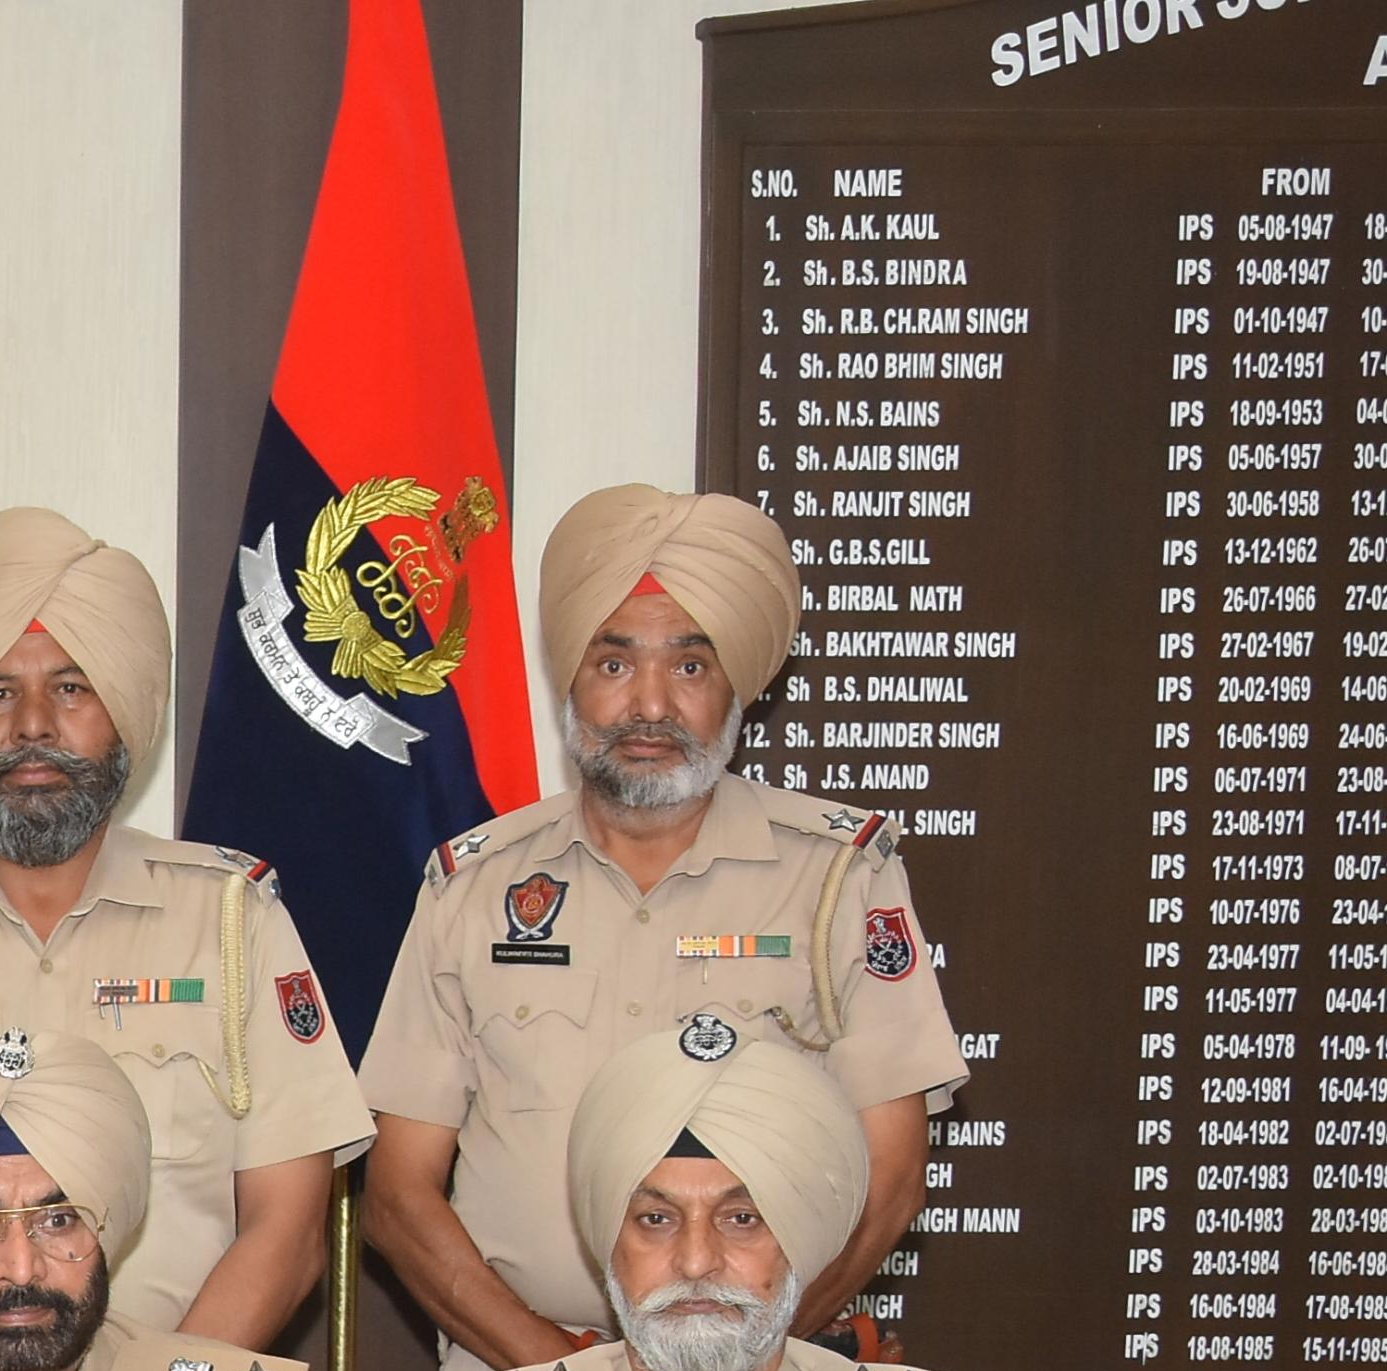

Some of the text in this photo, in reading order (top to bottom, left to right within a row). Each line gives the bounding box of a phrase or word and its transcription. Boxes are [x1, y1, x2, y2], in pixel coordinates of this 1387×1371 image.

[991, 0, 1204, 87] SENIOR
[752, 168, 1330, 197] S.NO. NAME FROM
[766, 216, 780, 241] 1.
[841, 214, 880, 240] A.K.
[887, 214, 939, 240] KAUL
[1179, 214, 1213, 240] IPS
[1239, 214, 1333, 241] 05-08-1947
[764, 261, 780, 286] 2.
[842, 259, 879, 285] B.S.
[886, 259, 967, 285] BINDRA
[1177, 259, 1211, 285] IPS
[1237, 258, 1330, 285] 19-08-1947
[762, 309, 779, 335] 3.
[841, 308, 878, 334] R.B.
[884, 308, 960, 334] CH.RAM
[966, 308, 1028, 334] SINGH
[1175, 308, 1209, 334] IPS
[1234, 307, 1328, 333] 01-10-1947
[760, 353, 777, 379] 4.
[838, 353, 878, 378] RAO
[885, 353, 935, 378] BHIM
[941, 353, 1003, 379] SINGH
[1173, 354, 1207, 379] IPS
[1233, 352, 1324, 378] 11-02-1951
[759, 401, 776, 426] 5.
[836, 401, 874, 427] N.S.
[880, 401, 939, 427] BAINS
[1170, 401, 1204, 427] IPS
[1230, 399, 1322, 426] 18-09-1953
[758, 445, 775, 471] 6.
[833, 445, 892, 471] AJAIB
[897, 445, 959, 471] SINGH
[1169, 445, 1202, 471] IPS
[1229, 444, 1322, 470] 05-06-1957
[832, 491, 904, 517] RANJIT
[908, 491, 970, 517] SINGH
[1166, 491, 1200, 517] IPS
[1227, 490, 1319, 517] 30-06-1958
[1163, 540, 1197, 565] IPS
[1225, 537, 1317, 564] 13-12-1962
[828, 585, 1315, 613] BIRBAL NATH IPS 26-07-1966
[826, 632, 948, 657] BAKHTAWAR
[954, 632, 1015, 657] SINGH
[1160, 633, 1194, 659] IPS
[1221, 632, 1314, 658] 27-02-1967
[825, 676, 861, 701] B.S.
[868, 677, 968, 702] DHALIWAL
[1158, 676, 1192, 702] IPS
[1218, 676, 1311, 702] 20-02-1969
[823, 723, 933, 748] BARJINDER
[938, 723, 1000, 748] SINGH
[1156, 723, 1189, 748] IPS
[1217, 724, 1308, 749] 16-06-1969
[821, 764, 855, 789] J.S.
[861, 764, 929, 789] ANAND
[1154, 767, 1188, 792] IPS
[1215, 767, 1305, 792] 06-07-1971
[914, 810, 976, 835] SINGH
[1212, 810, 1304, 835] 23-08-1971
[1151, 854, 1303, 880] IPS 17-11-1973
[1149, 897, 1299, 924] IPS 10-07-1976
[1146, 942, 1299, 970] IPS 23-04-1977
[1144, 986, 1297, 1013] IPS 11-05-1977
[1141, 1033, 1295, 1059] IPS 05-04-1978
[1139, 1075, 1290, 1103] IPS 12-09-1981
[948, 1121, 1005, 1146] BAINS
[1138, 1120, 1171, 1144] IPS
[1199, 1120, 1289, 1145] 18-04-1982
[1135, 1165, 1288, 1190] IPS 02-07-1983
[963, 1207, 1283, 1233] MANN IPS 03-10-1983
[1129, 1248, 1279, 1275] IPS 28-03-1984
[1127, 1294, 1160, 1318] IPS
[1190, 1294, 1275, 1318] 16-06-1984
[1188, 1336, 1273, 1360] 18-08-1985
